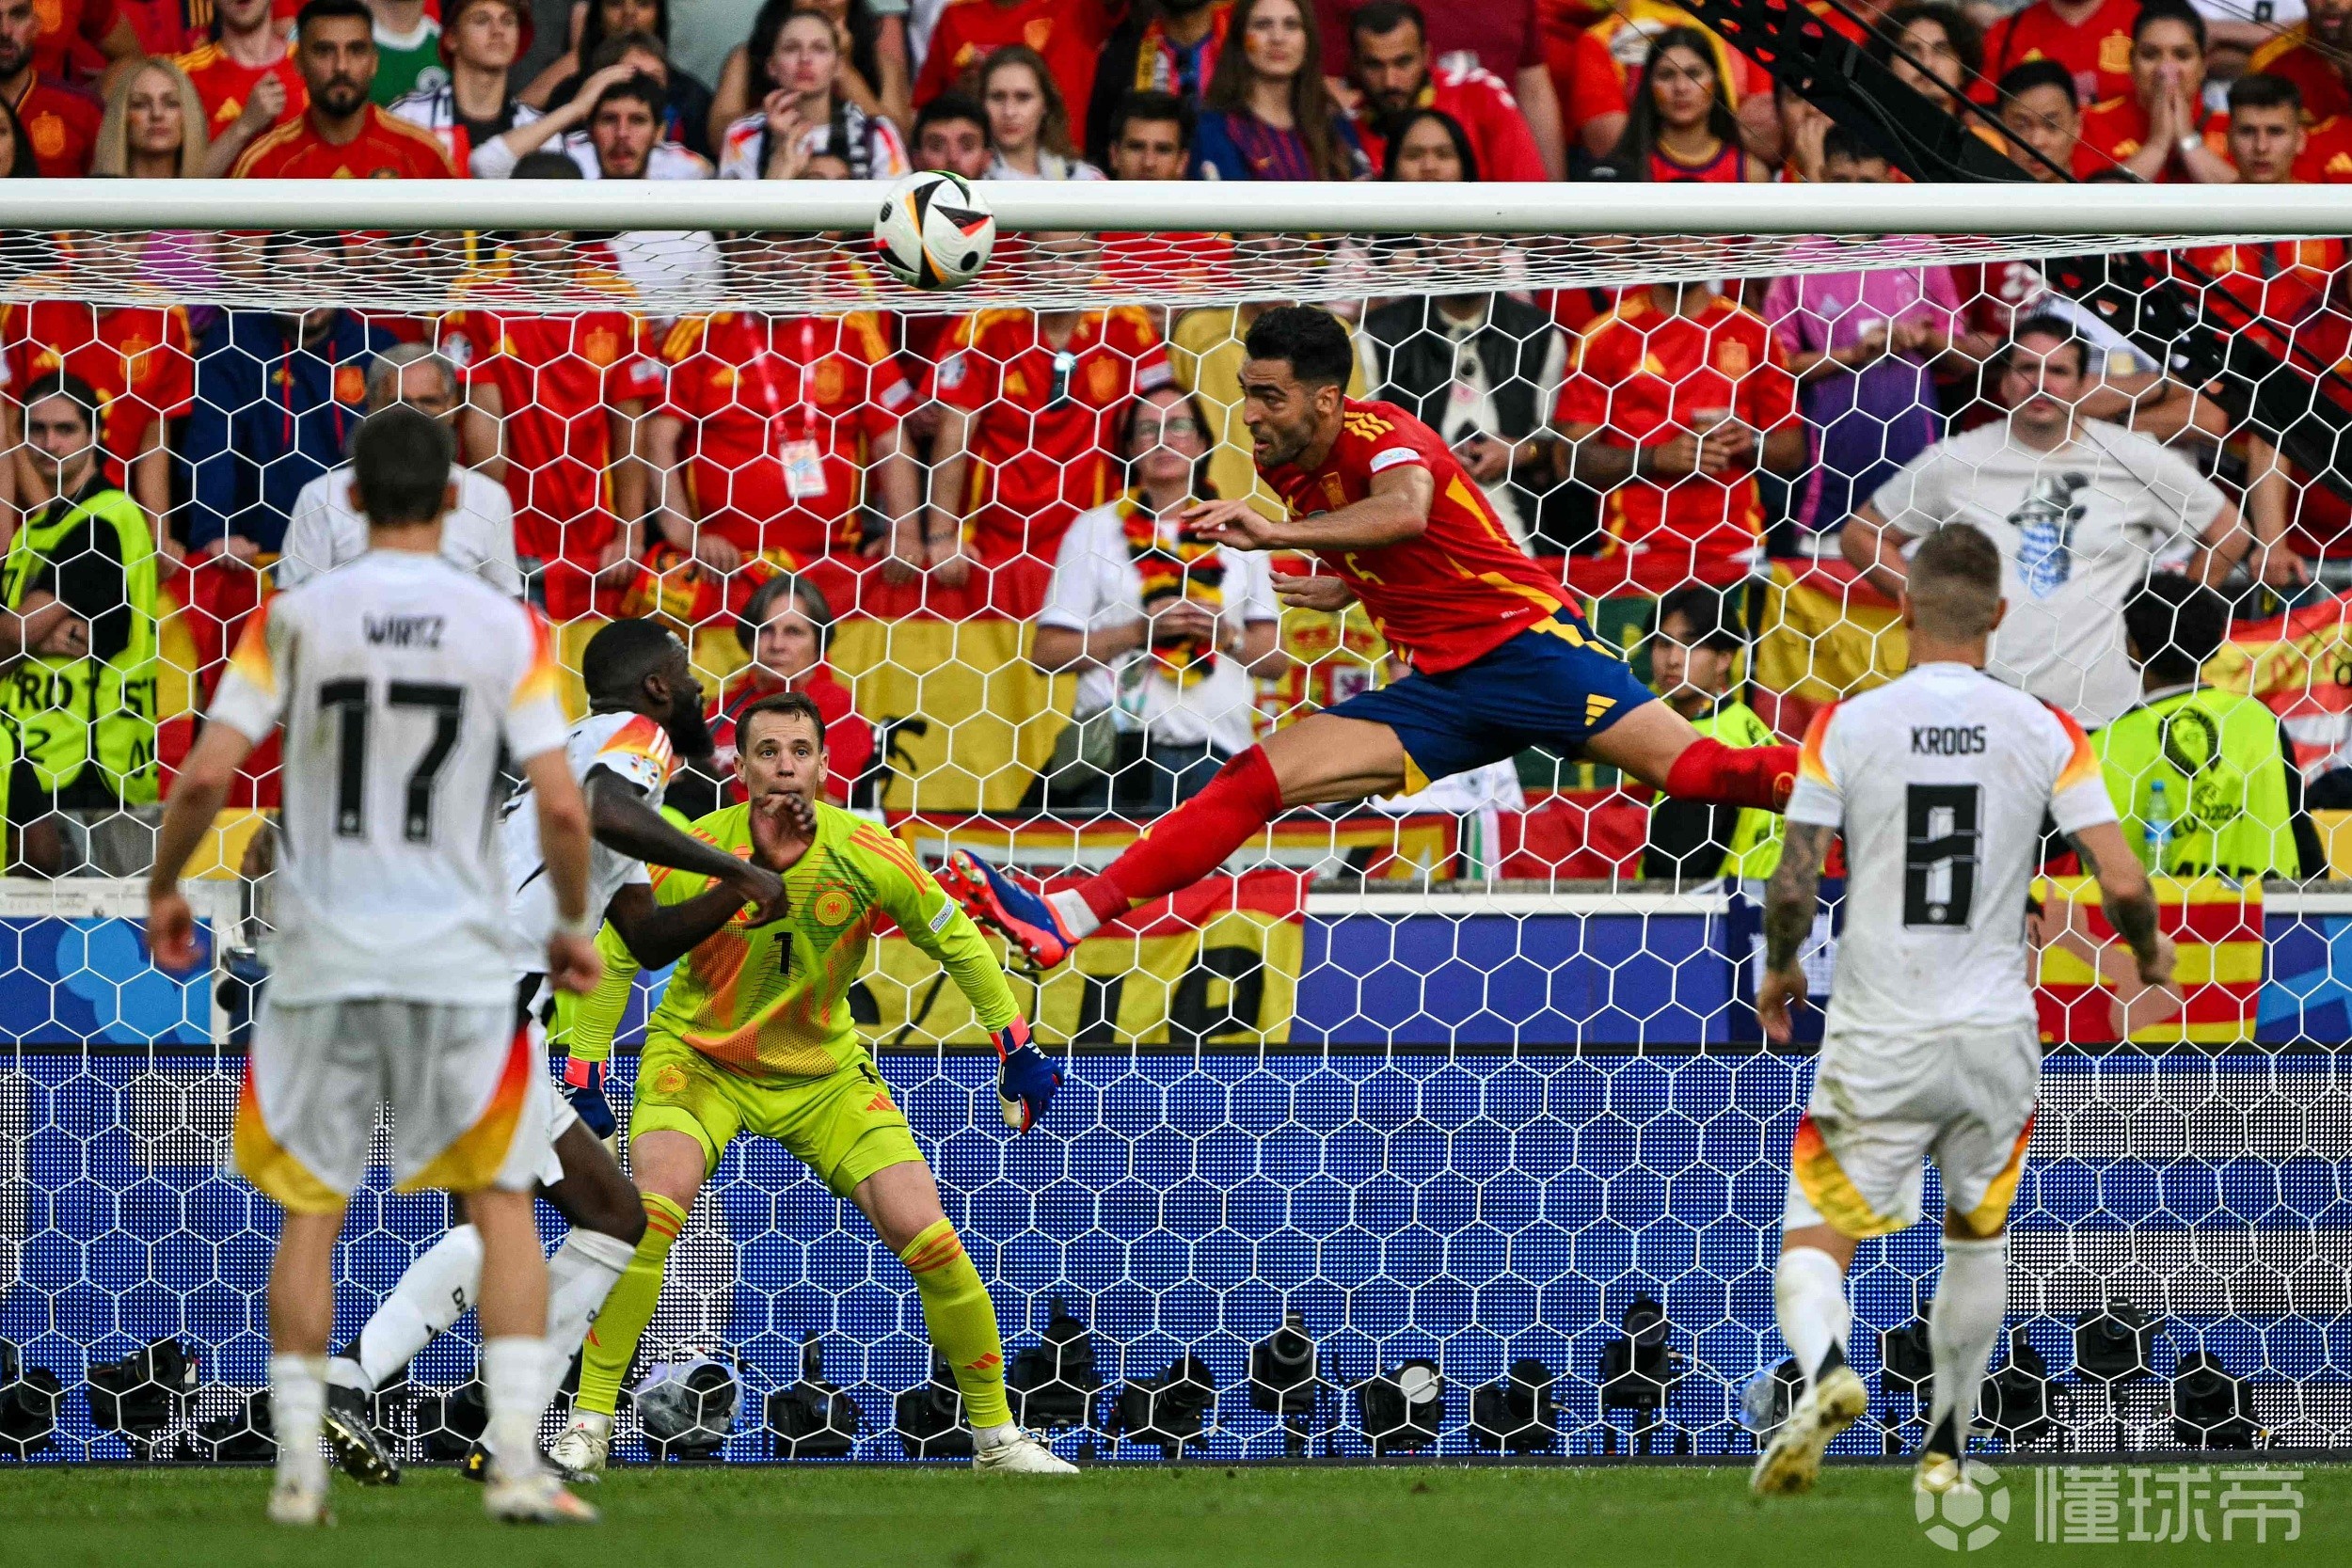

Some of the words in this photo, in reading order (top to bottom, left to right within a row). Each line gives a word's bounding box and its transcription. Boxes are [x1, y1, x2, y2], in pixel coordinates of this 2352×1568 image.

[363, 611, 445, 646] WIRTZ
[318, 675, 465, 840] 17
[1911, 726, 1987, 755] KROOS
[1903, 783, 1985, 931] 8
[772, 931, 794, 976] 1
